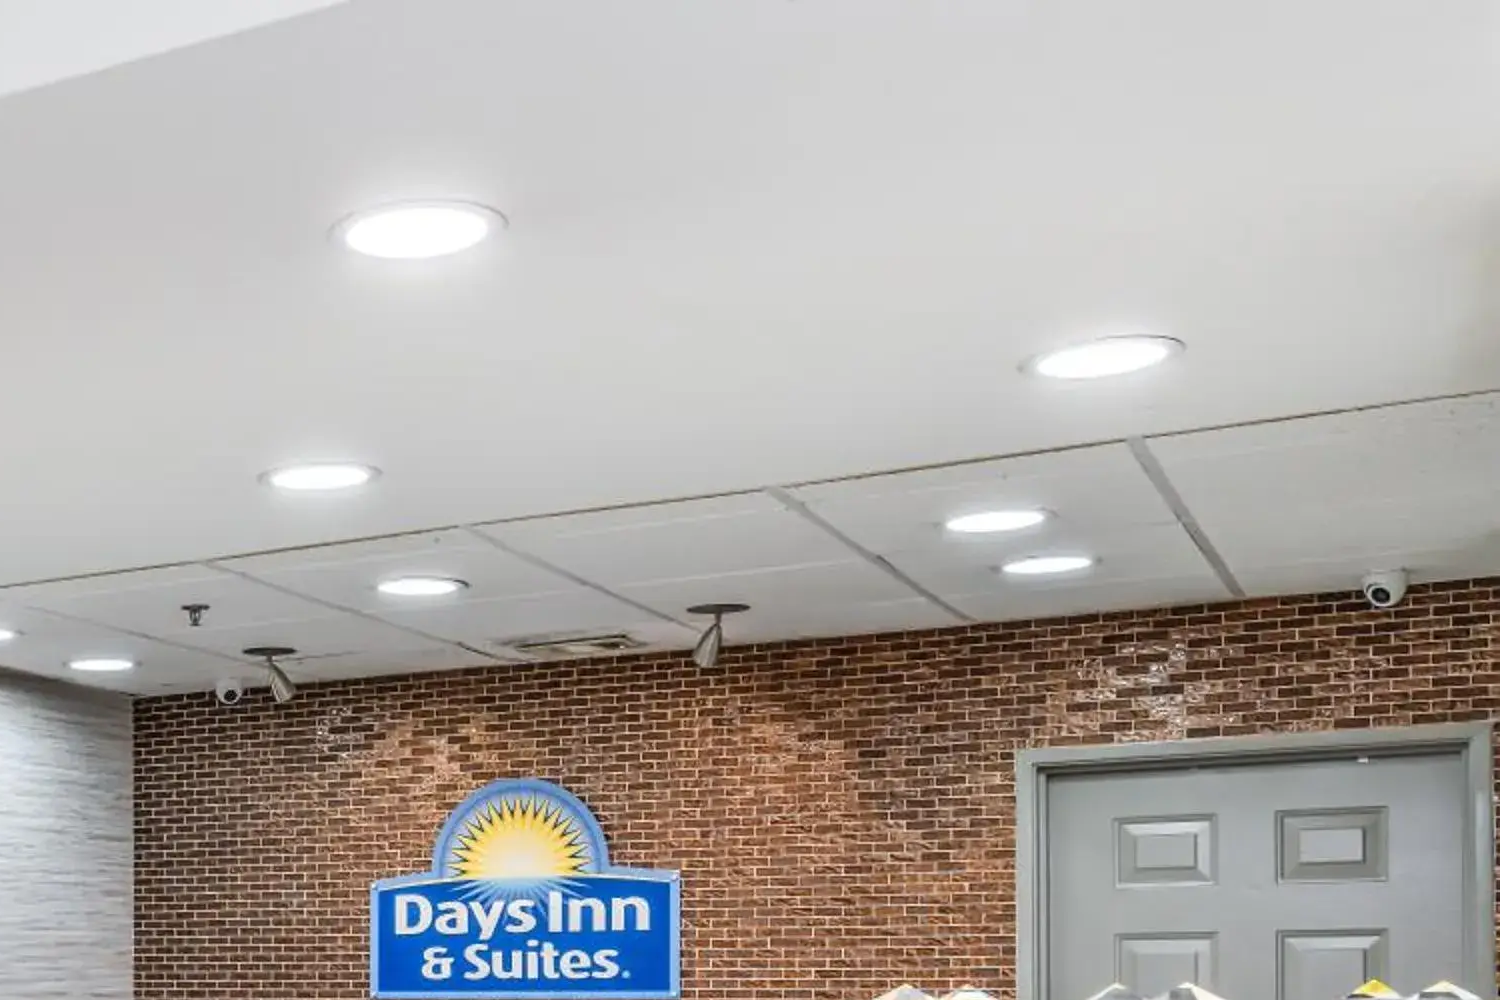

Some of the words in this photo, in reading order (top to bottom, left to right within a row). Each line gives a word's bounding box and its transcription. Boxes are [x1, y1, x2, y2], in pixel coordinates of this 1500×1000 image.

[394, 893, 537, 940] Days
[548, 890, 651, 933] Inn
[421, 946, 455, 980] &
